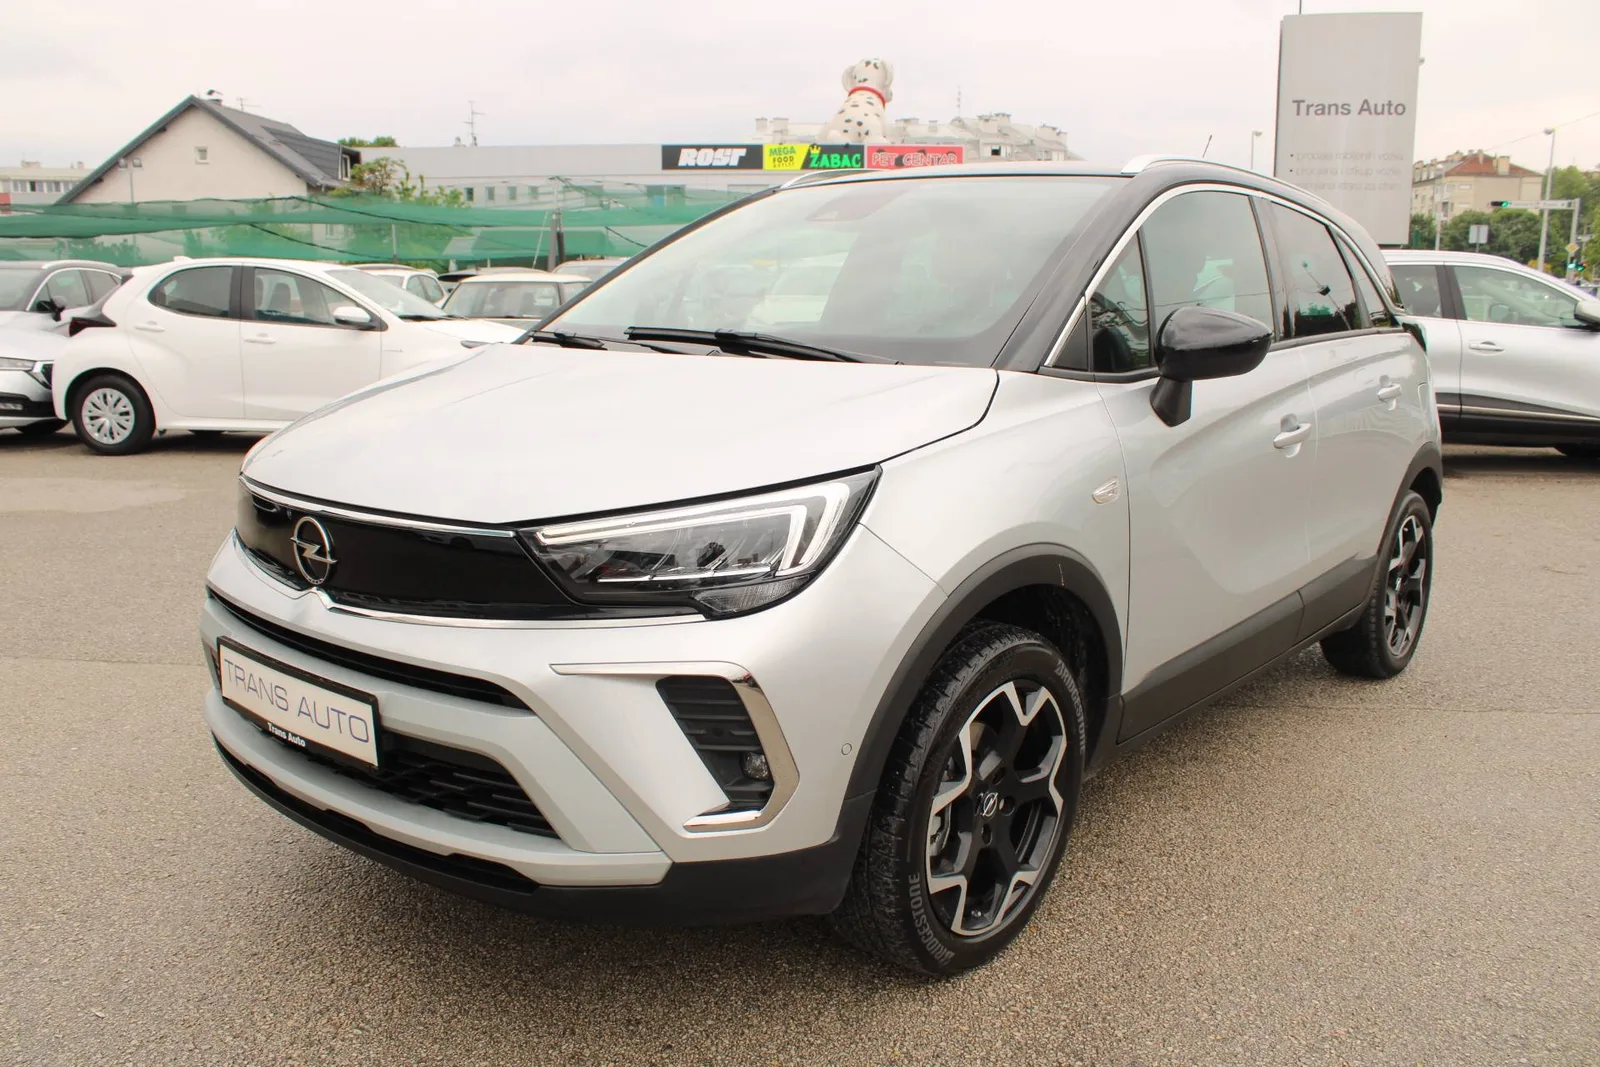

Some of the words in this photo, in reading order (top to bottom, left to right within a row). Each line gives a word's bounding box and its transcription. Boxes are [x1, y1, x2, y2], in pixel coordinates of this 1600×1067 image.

[1292, 99, 1351, 116] Trans
[1357, 99, 1406, 116] Auto
[678, 148, 747, 167] ROST
[769, 146, 796, 156] MEGA
[773, 156, 794, 164] FOOD
[872, 152, 898, 166] PET
[902, 152, 958, 166] CENTAR
[224, 658, 289, 712] TRANS
[298, 696, 369, 743] AUTO
[1054, 659, 1086, 755] BRIDGESTONE
[267, 722, 287, 739] Trans
[288, 732, 306, 747] Auto
[908, 872, 955, 966] BRIDGESTONE
